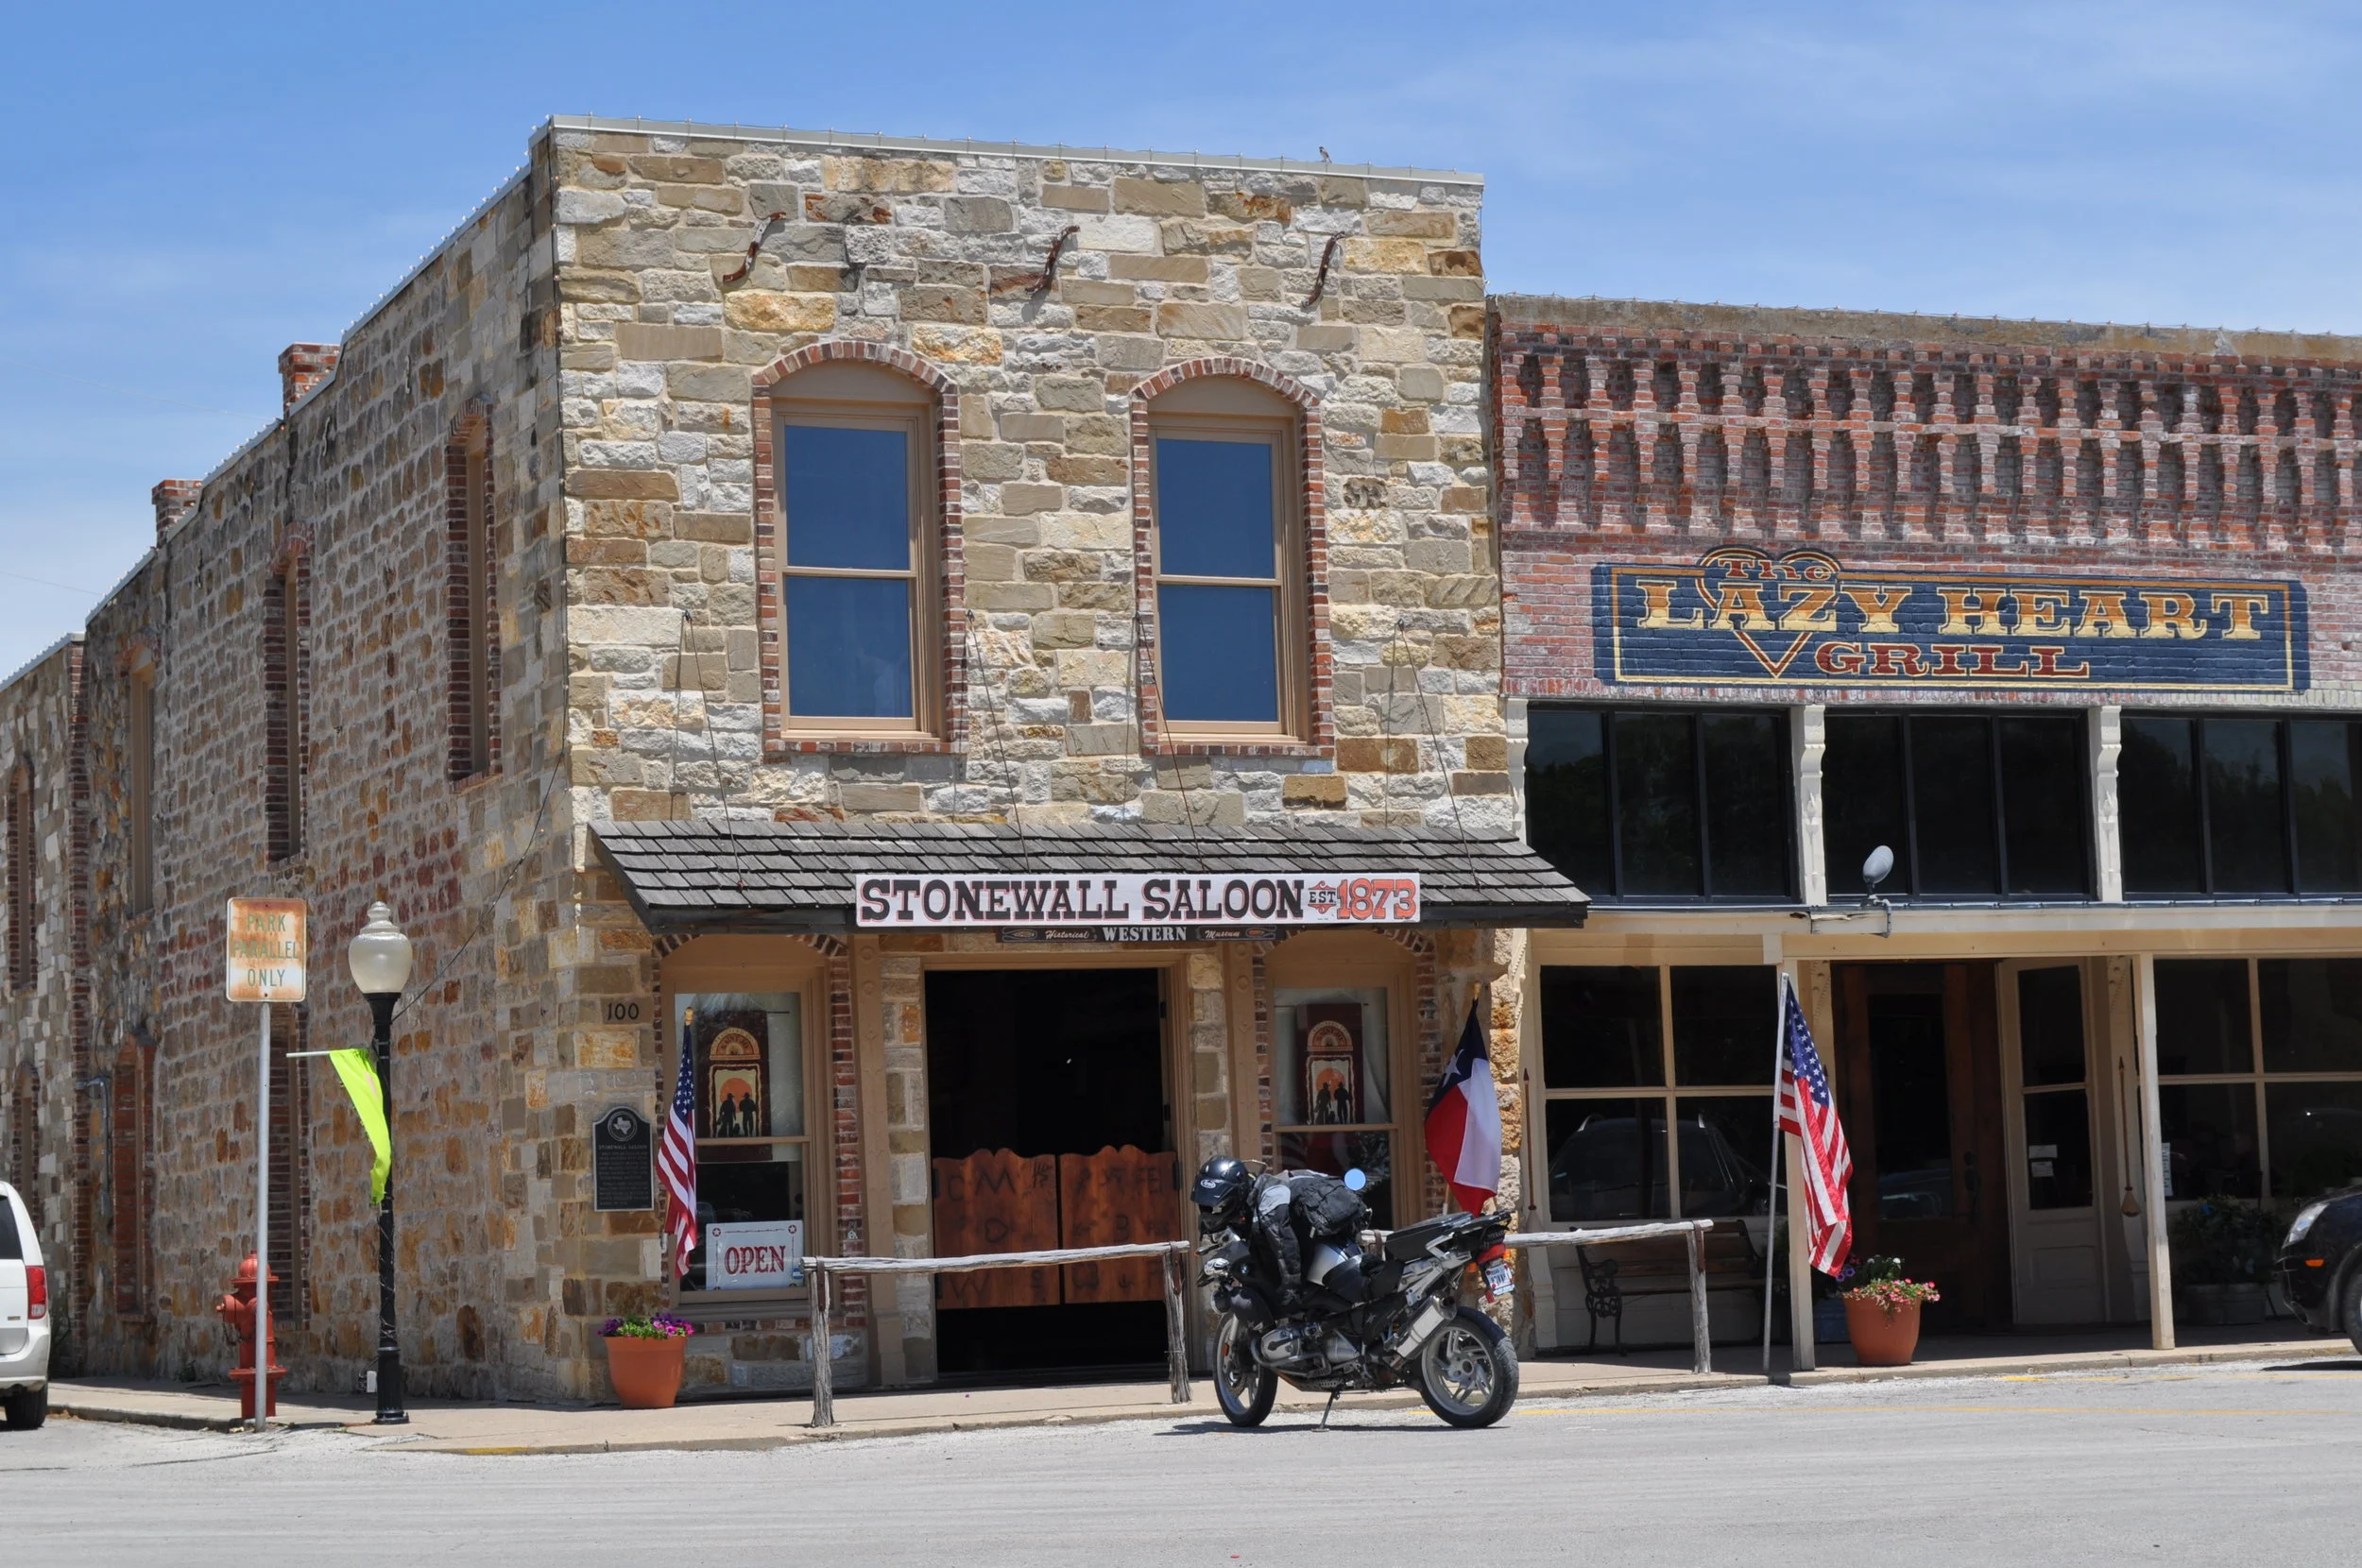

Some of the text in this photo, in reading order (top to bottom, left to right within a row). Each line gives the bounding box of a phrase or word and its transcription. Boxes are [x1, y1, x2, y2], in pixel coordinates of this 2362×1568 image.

[1718, 557, 1832, 581] The
[1635, 578, 2268, 640] LAZY HEART
[1814, 641, 2090, 678] GRILL
[860, 879, 1130, 922] STONEWALL
[1141, 878, 1305, 921] SALOON
[1336, 877, 1416, 919] 1873
[247, 913, 286, 932] PARK
[1045, 929, 1090, 940] Historical
[1102, 927, 1188, 942] WESTERN
[232, 940, 299, 960] PARALLEL
[247, 968, 286, 987] ONLY
[608, 1002, 640, 1020] 100
[725, 1245, 786, 1274] OPEN
